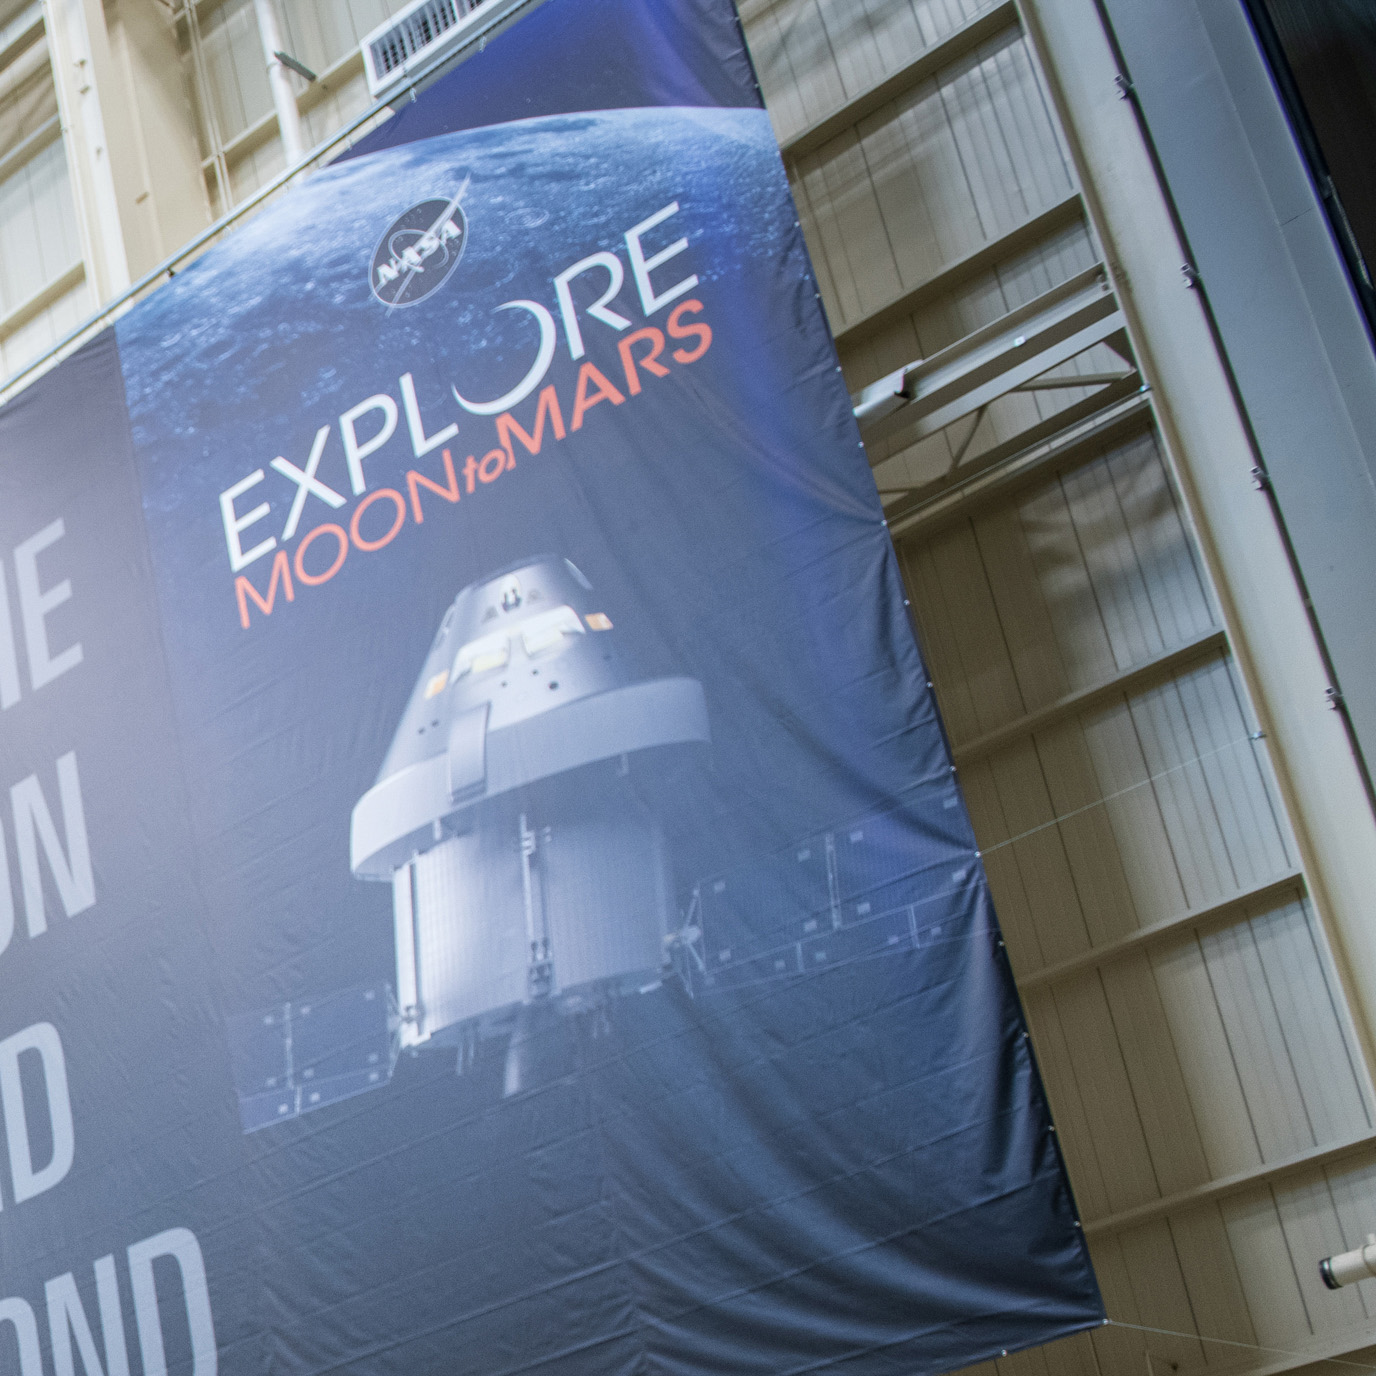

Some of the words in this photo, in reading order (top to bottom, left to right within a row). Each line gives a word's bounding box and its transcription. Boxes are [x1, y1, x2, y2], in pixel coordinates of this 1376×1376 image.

[219, 202, 700, 572] EXPLORE
[377, 219, 462, 286] NASA
[232, 449, 460, 629] MOON
[494, 298, 714, 470] MARS
